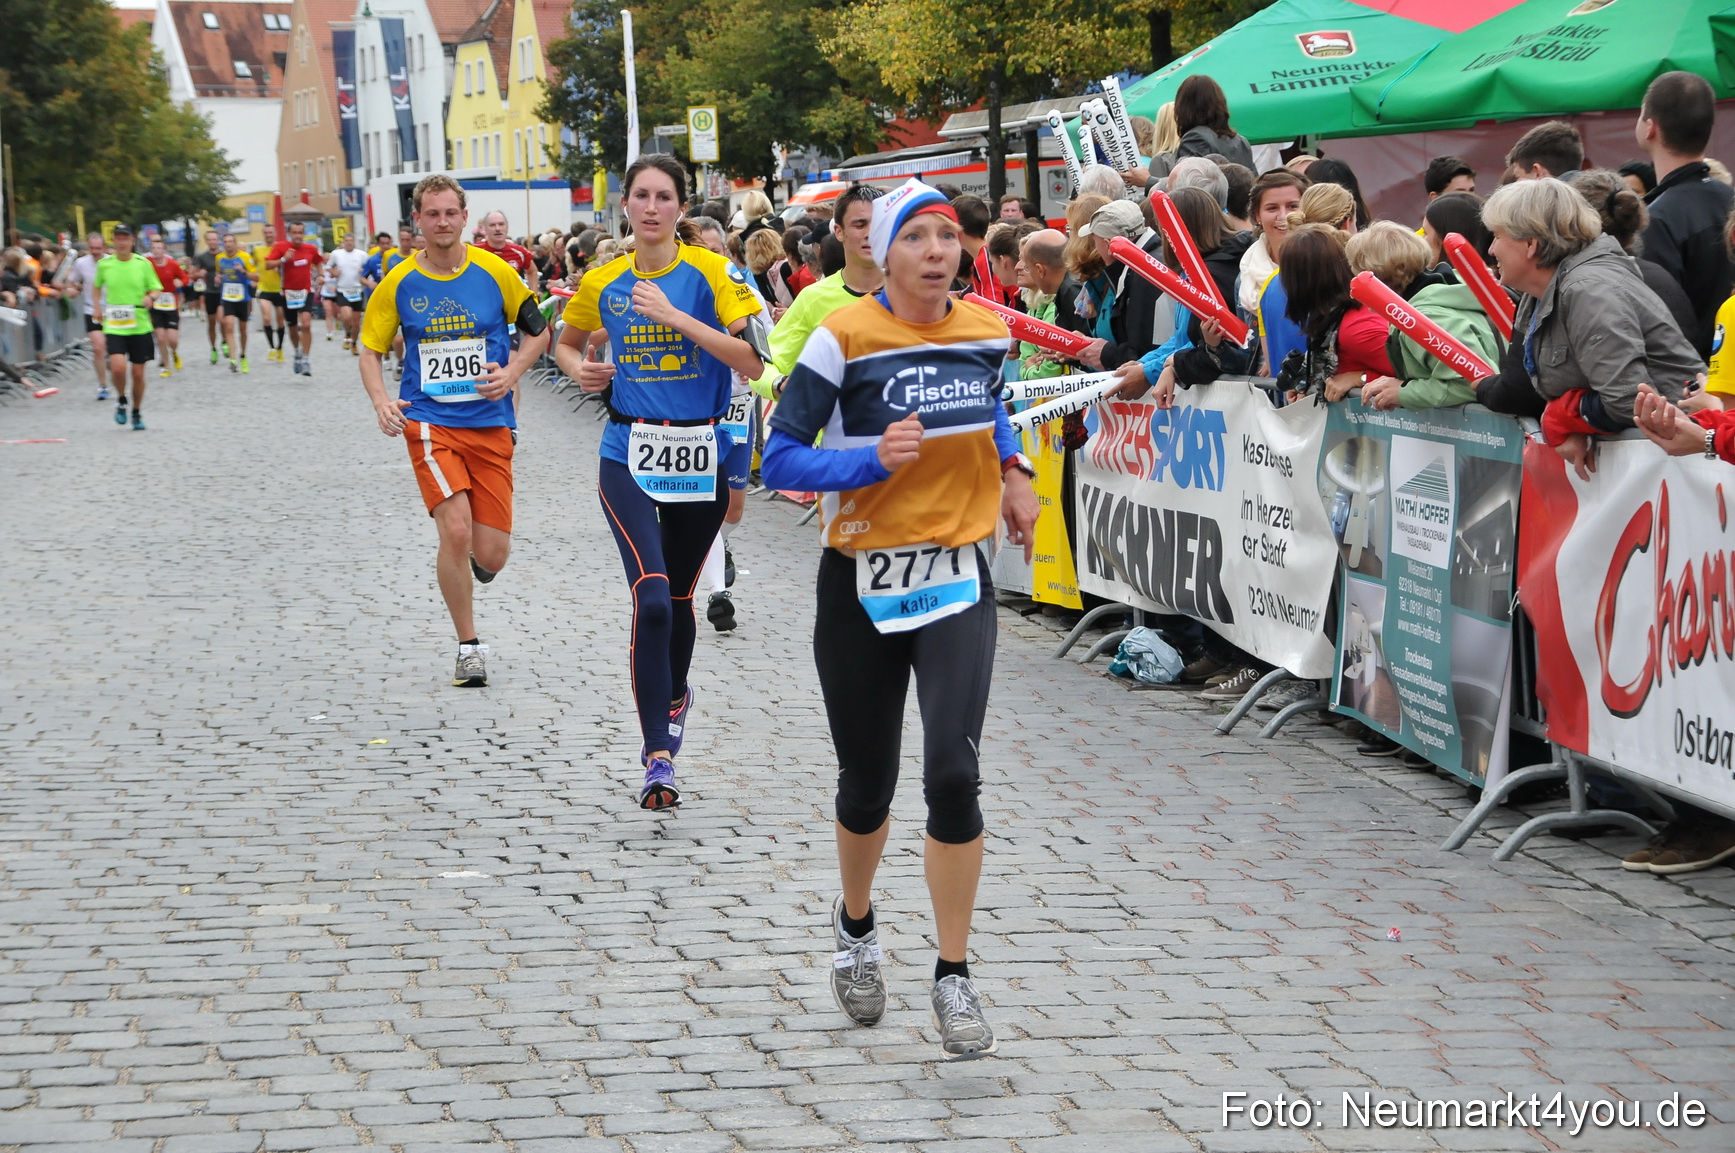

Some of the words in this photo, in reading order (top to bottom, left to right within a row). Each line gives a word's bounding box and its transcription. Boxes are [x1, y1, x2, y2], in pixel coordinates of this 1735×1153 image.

[1272, 60, 1396, 79] Neumarkte
[735, 285, 752, 297] PAR
[1176, 276, 1196, 295] BKK
[1198, 292, 1223, 310] Audi
[1025, 322, 1046, 337] BKK
[1049, 331, 1074, 346] Audi
[420, 348, 442, 356] PARTL
[1423, 331, 1452, 357] BKK
[428, 354, 481, 380] 2496
[1451, 352, 1485, 378] Audi
[441, 384, 470, 394] Tobias
[905, 378, 988, 404] Fischer
[917, 397, 987, 413] AUTOMOBILE
[1031, 402, 1068, 428] BMW
[631, 431, 660, 440] PARTL
[662, 434, 702, 442] Neumarkt
[637, 444, 709, 472] 2480
[645, 479, 699, 491] Katharina
[1419, 502, 1450, 526] HOFFER
[1035, 553, 1056, 564] auern
[900, 594, 938, 614] Katja
[1595, 478, 1735, 719] Chari
[1404, 647, 1433, 671] Trockenbau
[1674, 708, 1735, 780] Ostba
